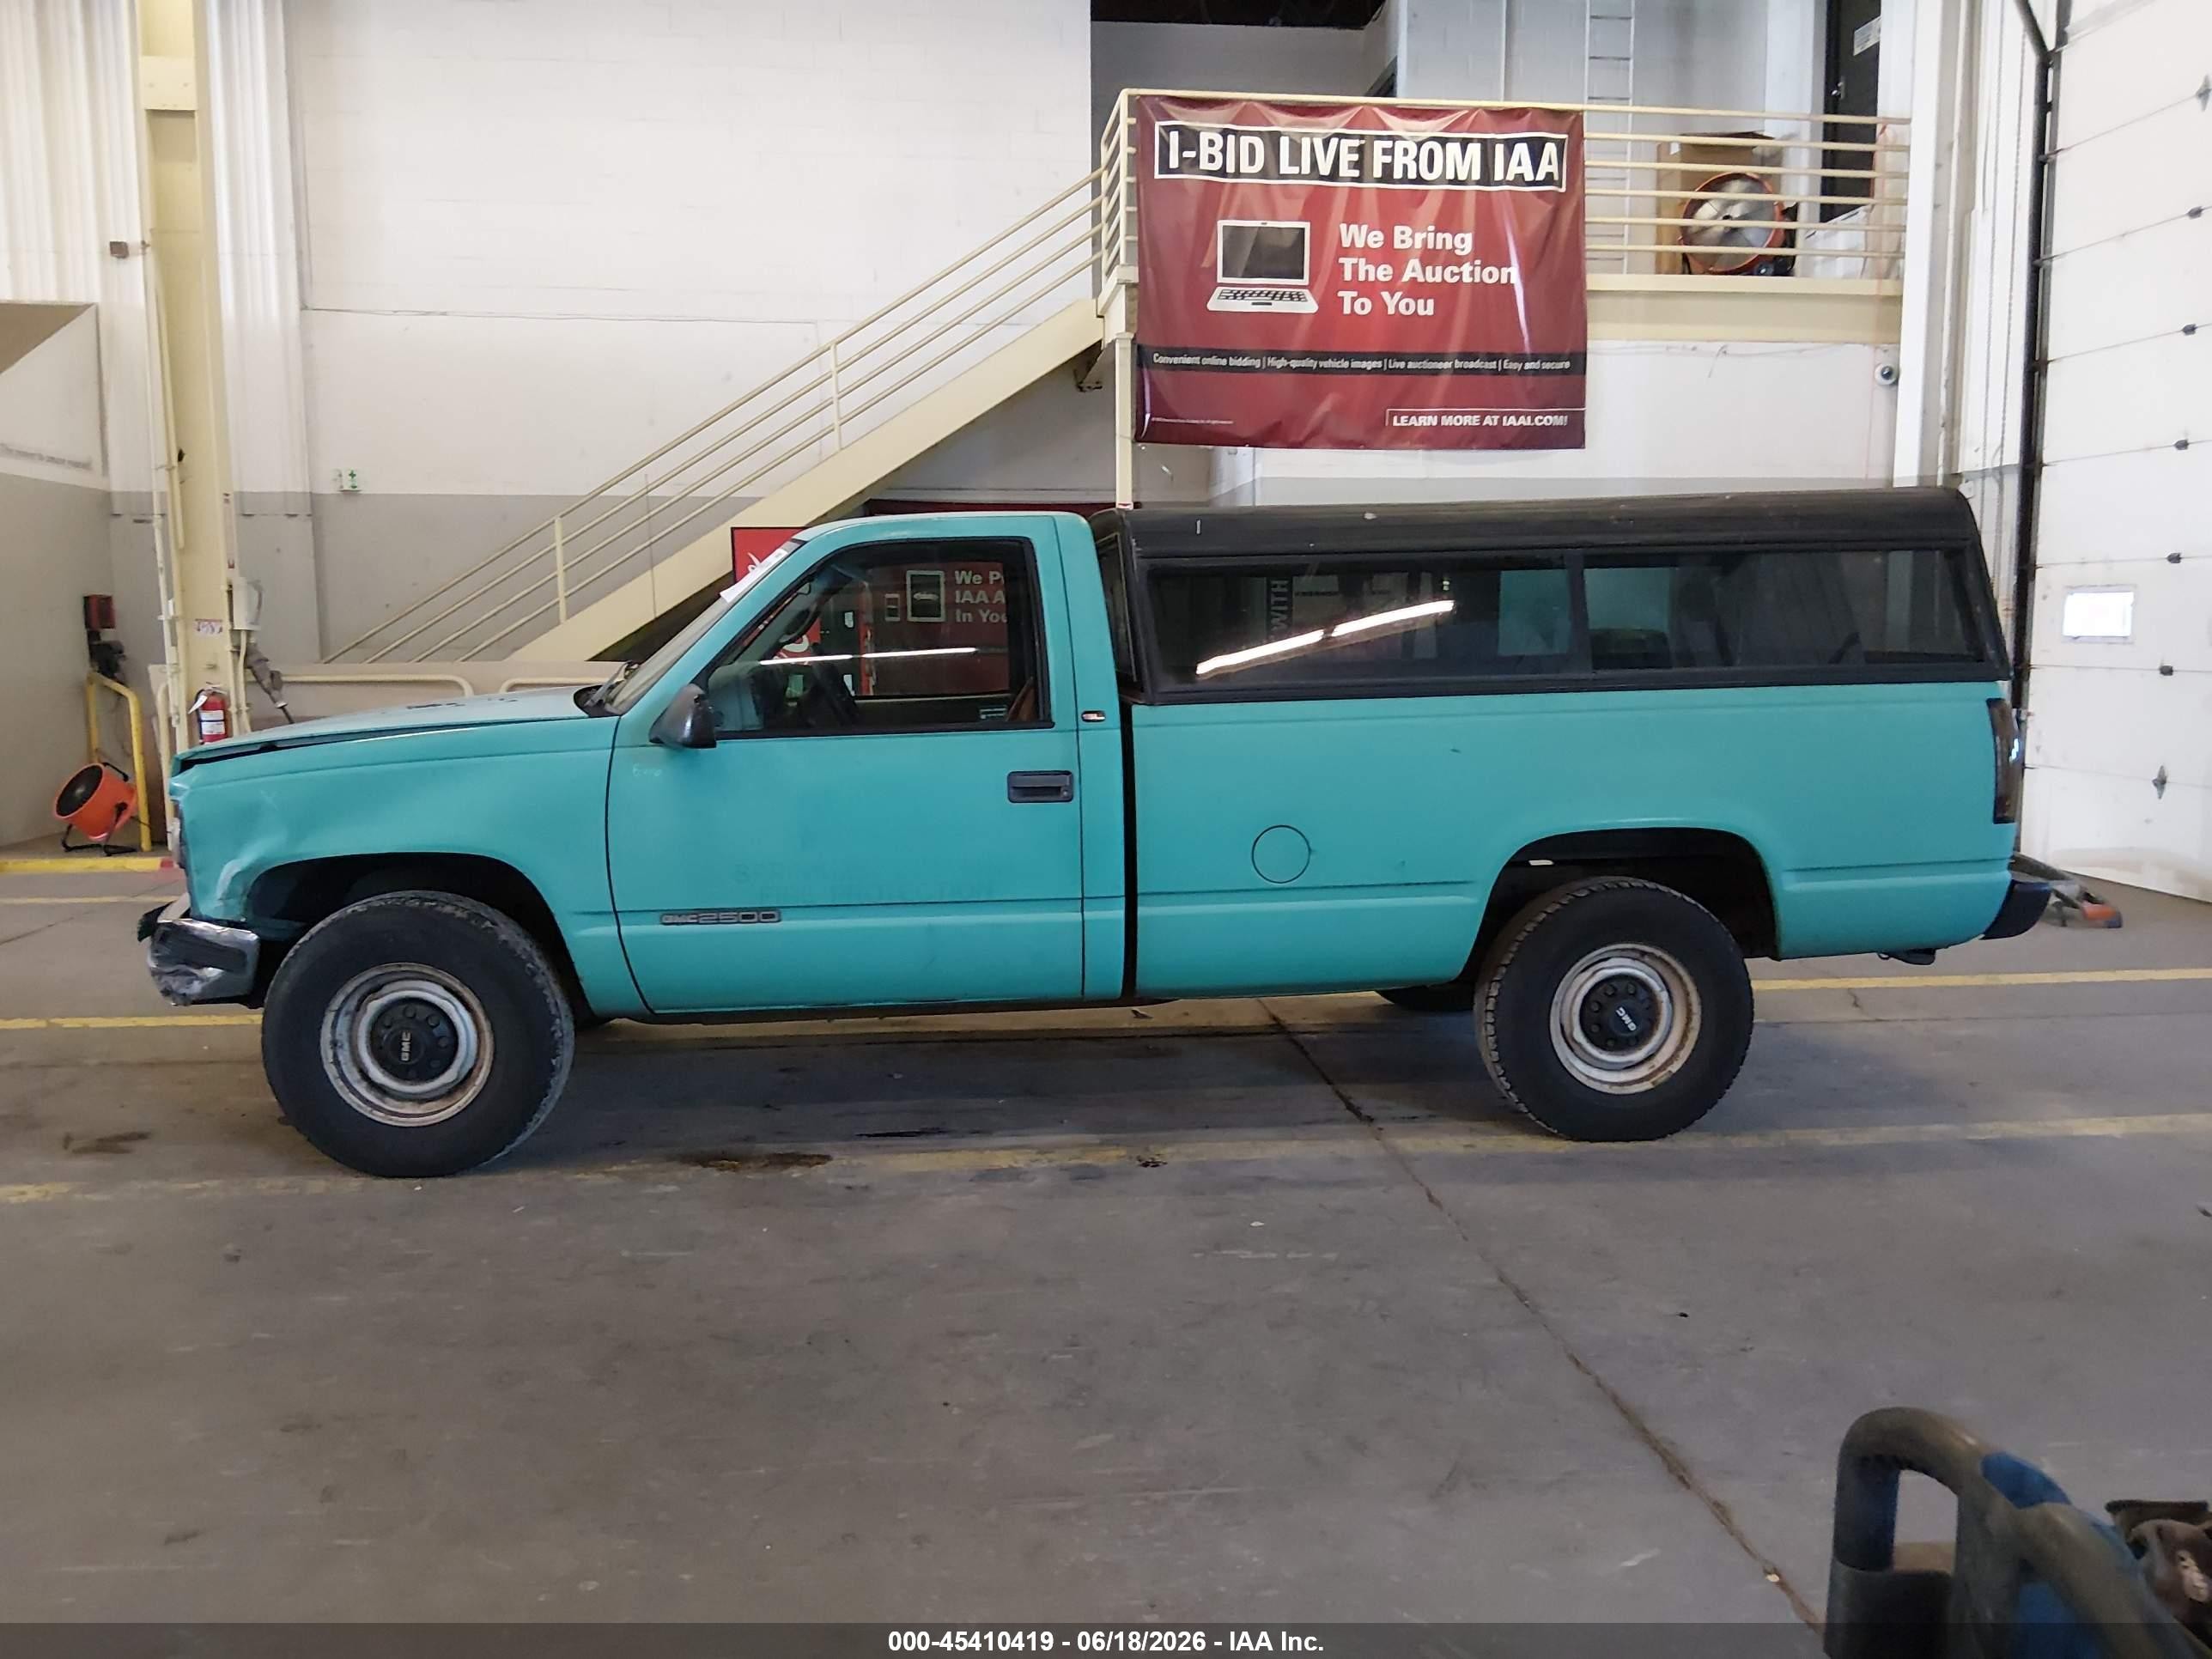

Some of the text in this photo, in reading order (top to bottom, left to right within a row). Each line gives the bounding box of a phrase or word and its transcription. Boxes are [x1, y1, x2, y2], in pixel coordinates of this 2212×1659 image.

[1169, 131, 1559, 182] I-BID LIVE FROM IAA
[1339, 223, 1473, 256] We Bring
[1338, 257, 1518, 284] The Auction
[1337, 290, 1435, 316] To You
[1153, 353, 1200, 364] Convenient
[1201, 356, 1227, 366] online
[1229, 356, 1261, 368] bidding
[1267, 356, 1317, 370] High-quality
[1318, 358, 1350, 368] vehicle
[1351, 358, 1382, 370] images
[1389, 359, 1406, 369] Live
[1407, 359, 1453, 369] auctioneer
[1454, 359, 1497, 369] broadcast
[1503, 359, 1523, 371] Easy
[1523, 360, 1540, 370] and
[1541, 361, 1571, 370] secure
[1393, 415, 1438, 427] LEARN
[1440, 415, 1480, 427] MORE
[1482, 415, 1499, 427] AT
[954, 570, 1005, 585] We P
[955, 590, 989, 604] IAA
[955, 608, 973, 623] In
[698, 911, 779, 924] 2500
[1615, 1006, 1637, 1031] GMC
[400, 1031, 411, 1062] GMC
